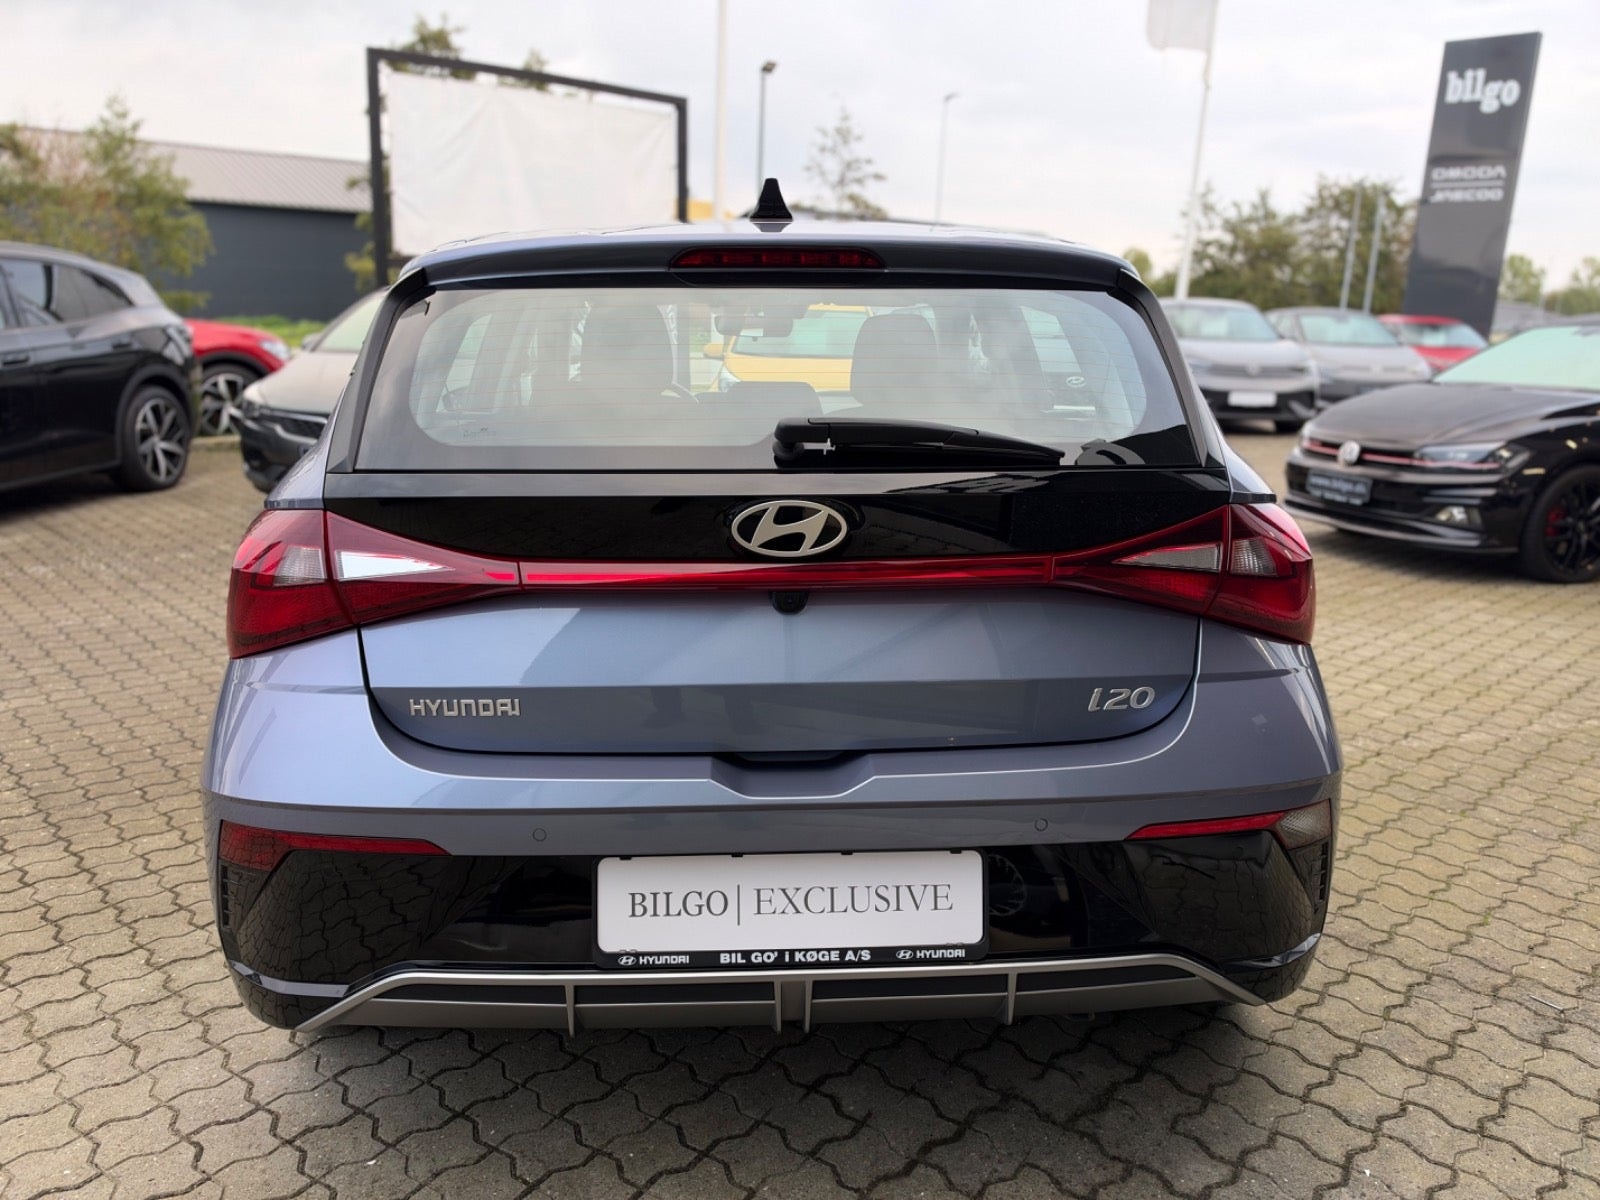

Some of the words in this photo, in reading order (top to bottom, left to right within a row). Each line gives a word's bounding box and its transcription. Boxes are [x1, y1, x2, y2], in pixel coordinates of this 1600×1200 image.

[1445, 67, 1520, 114] bilgo
[409, 698, 521, 717] HYUNDAI
[628, 890, 729, 919] BILGO
[752, 883, 954, 917] EXCLUSIVE
[639, 954, 690, 965] HYUNDAI
[719, 952, 747, 965] BIL
[794, 949, 841, 963] KØGE
[844, 949, 872, 963] A/S
[915, 948, 966, 960] HYUNDAI
